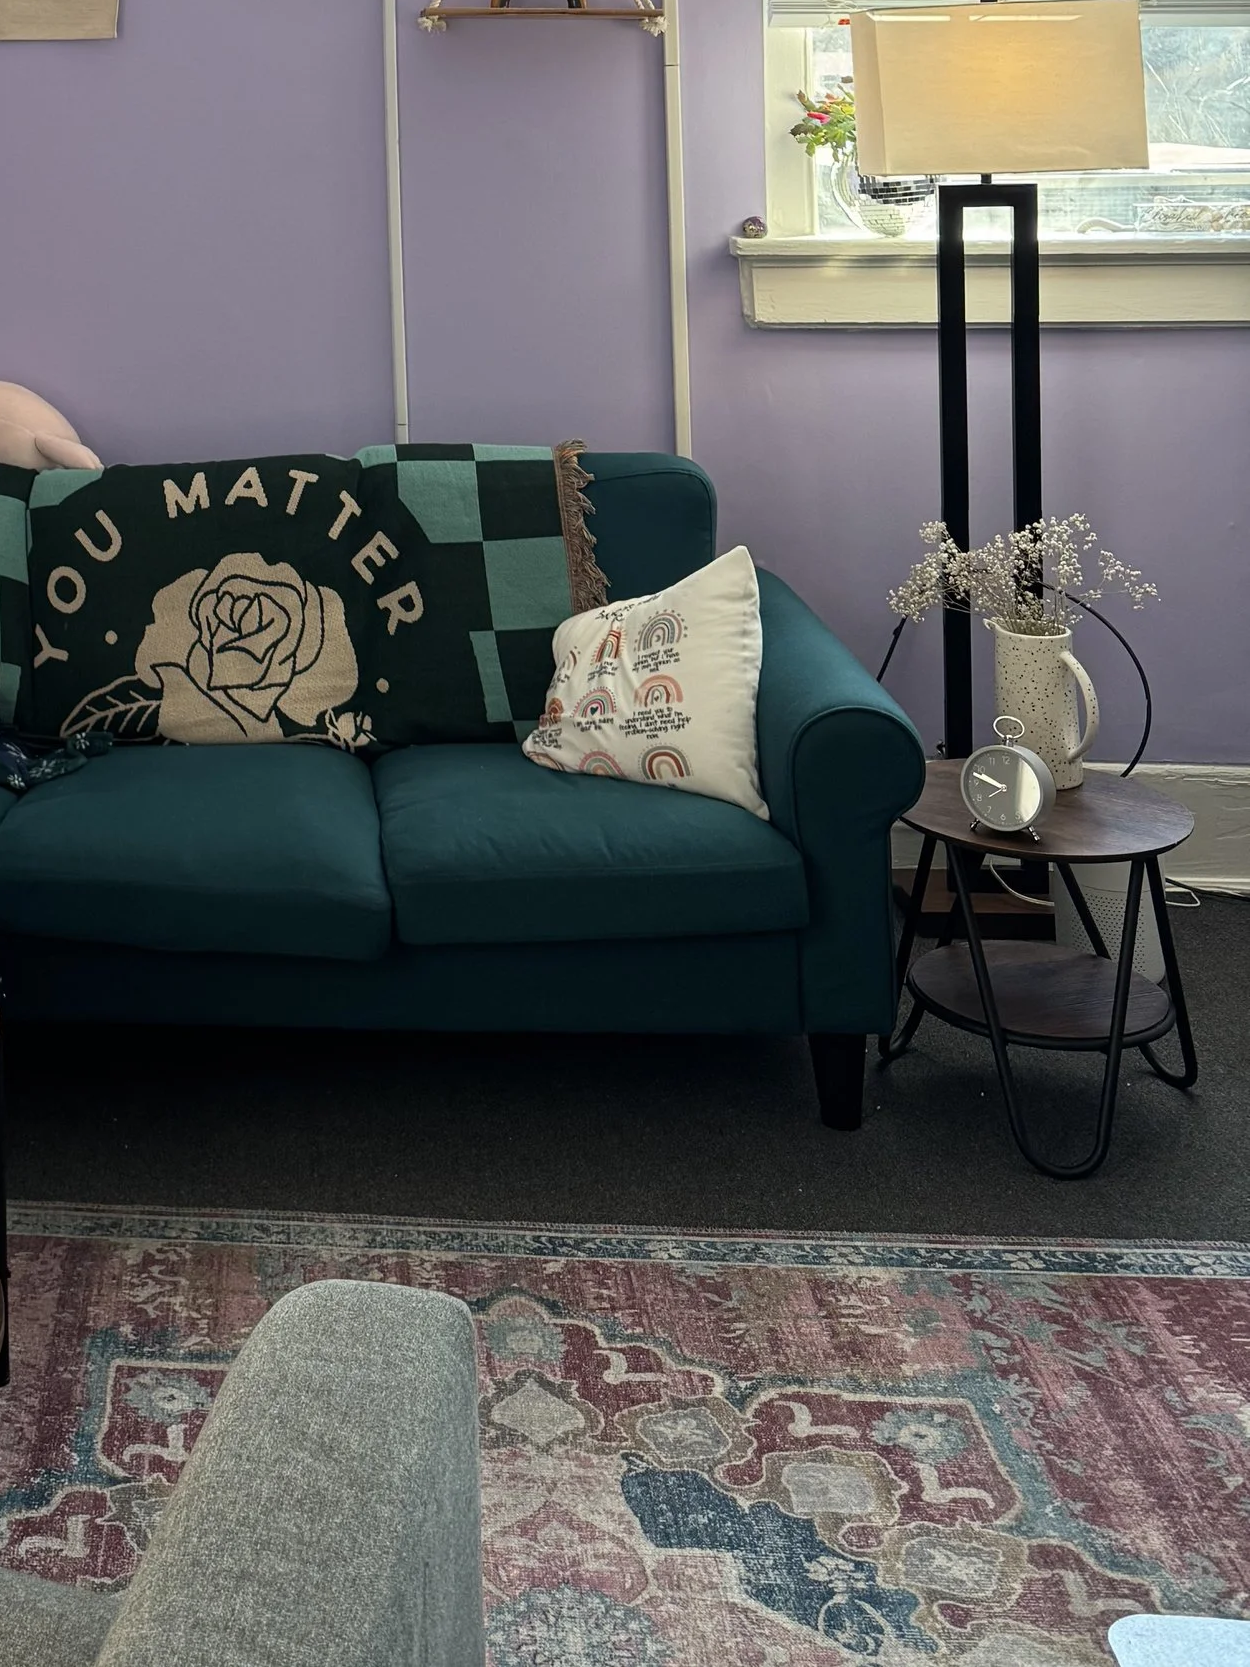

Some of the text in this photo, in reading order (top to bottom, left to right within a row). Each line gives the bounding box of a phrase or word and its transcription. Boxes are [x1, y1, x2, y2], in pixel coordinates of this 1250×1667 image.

[33, 466, 424, 669] YOU MATTER
[1002, 755, 1011, 765] 12
